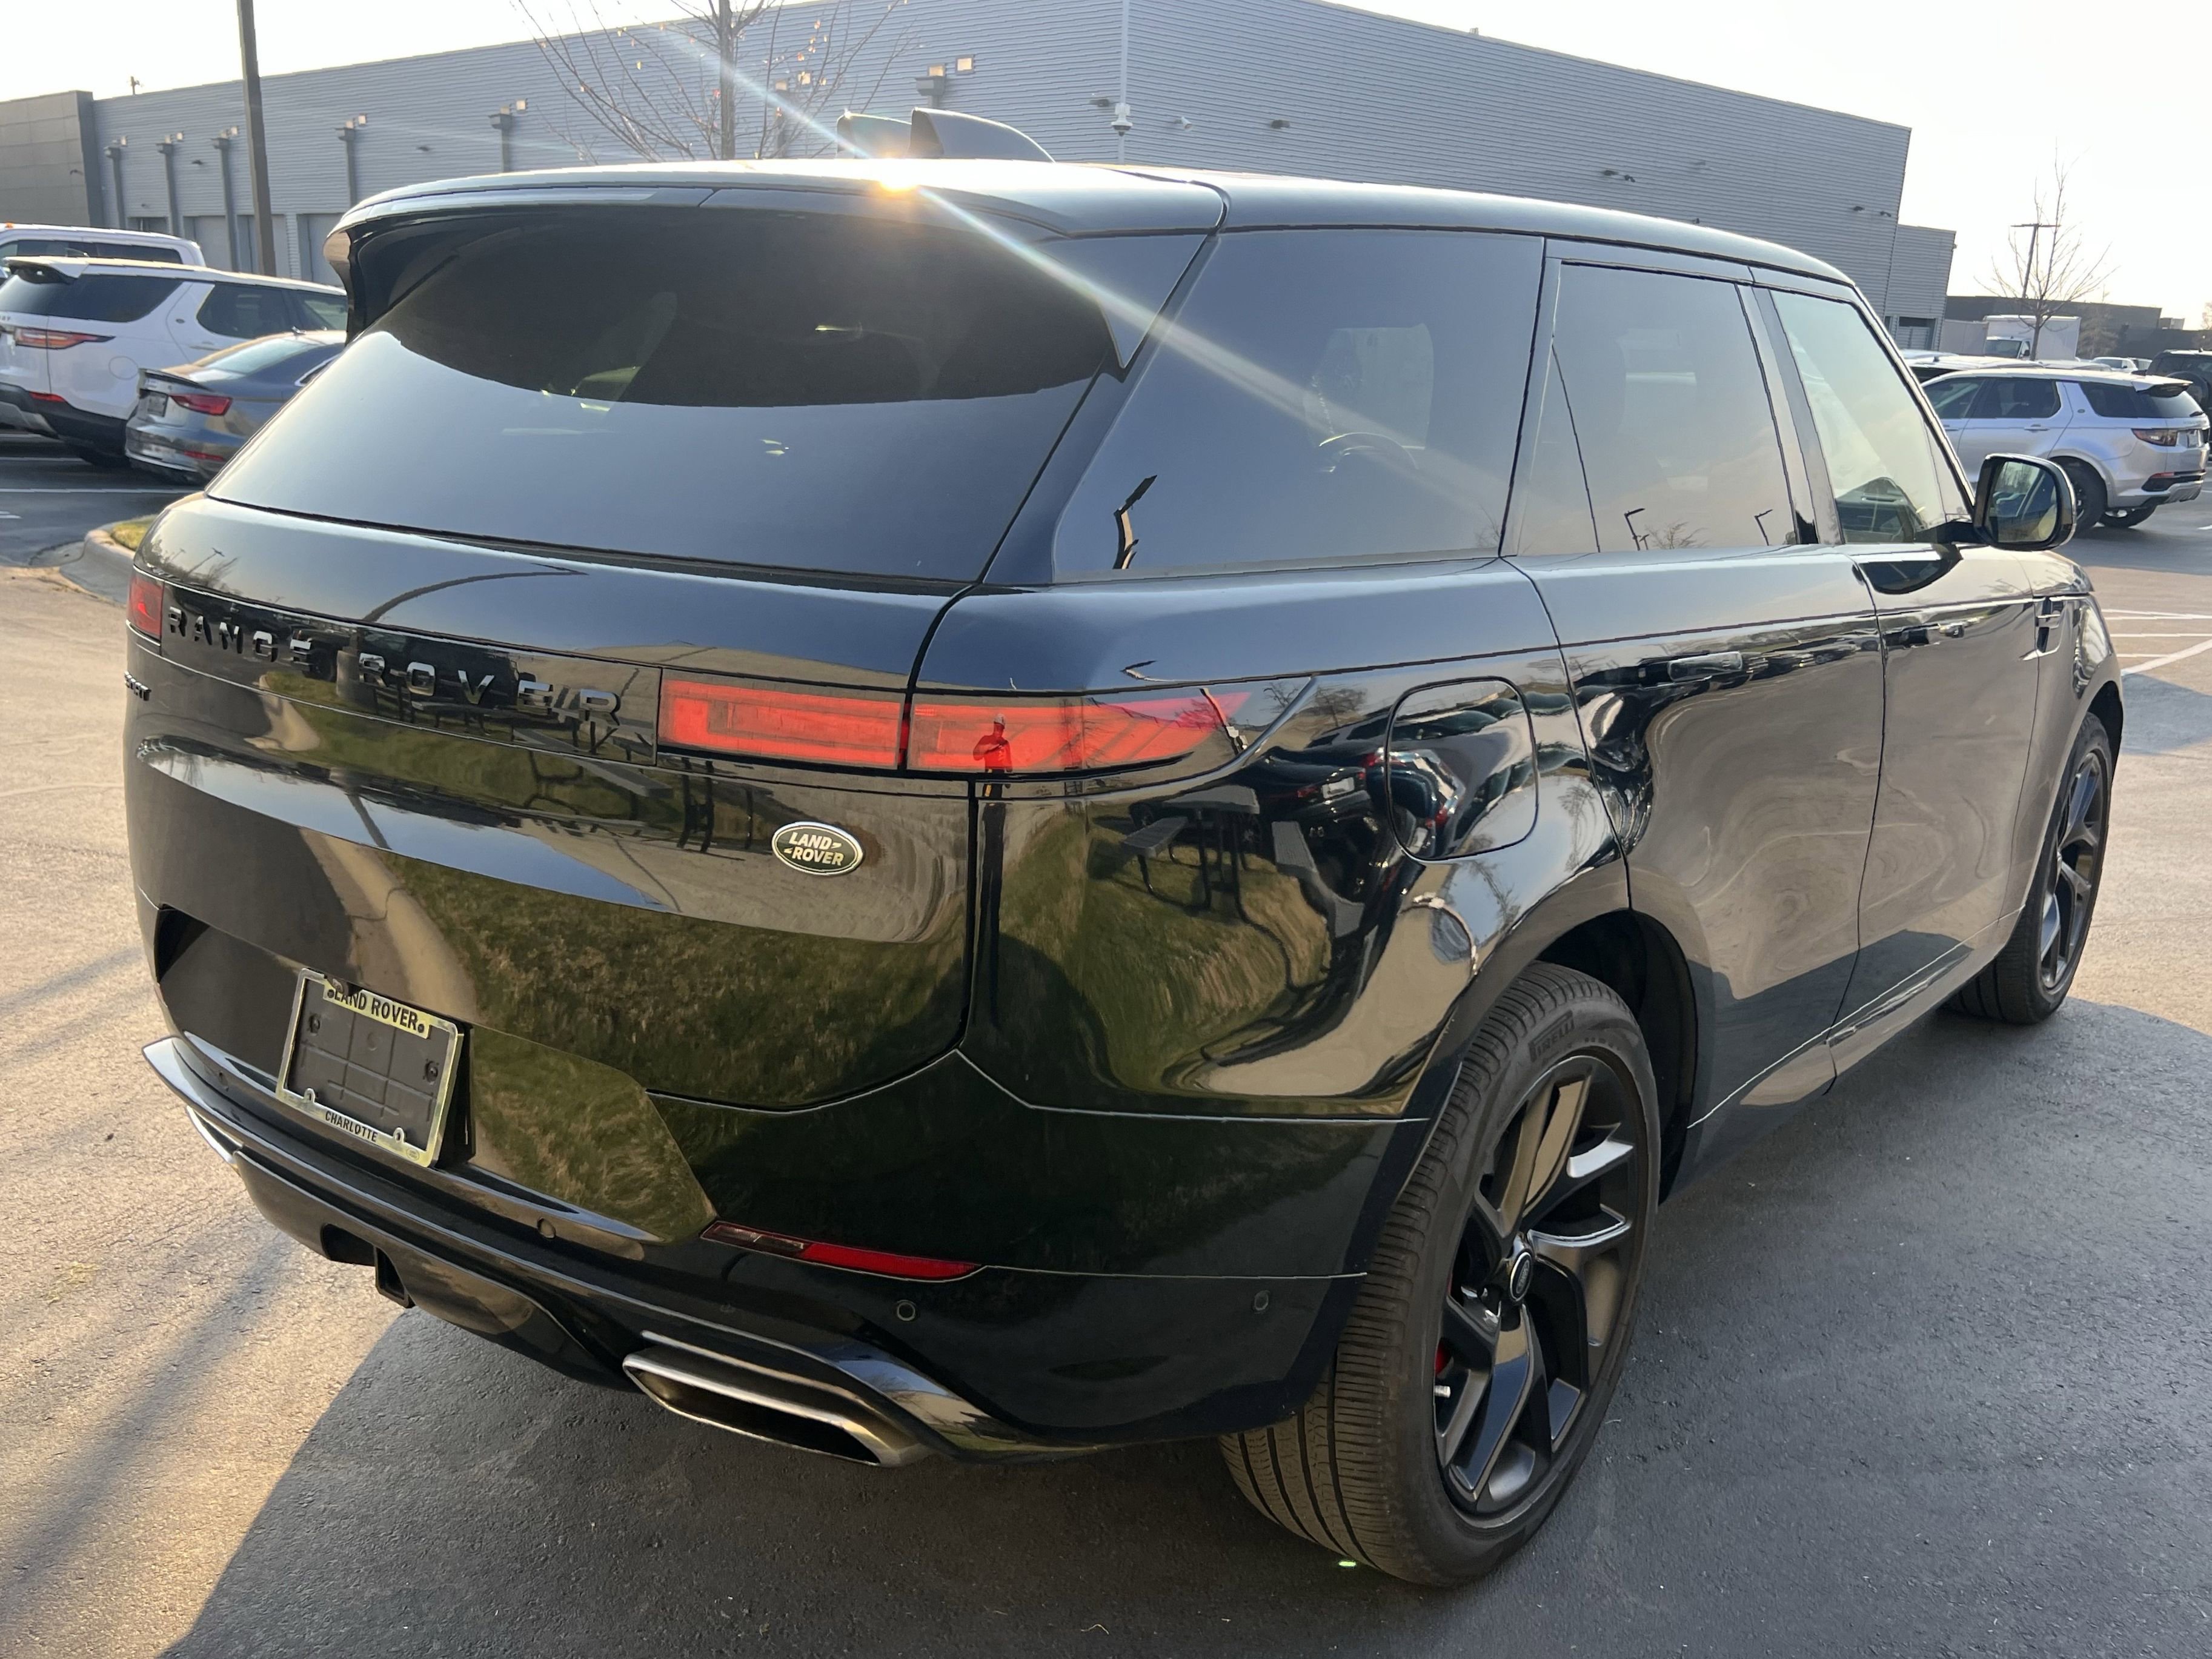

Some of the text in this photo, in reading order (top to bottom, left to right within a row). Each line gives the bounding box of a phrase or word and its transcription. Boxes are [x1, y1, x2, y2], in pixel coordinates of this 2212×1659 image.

[168, 605, 622, 729] RANGE ROVER
[788, 831, 833, 851] LAND
[791, 846, 845, 866] ROVER
[334, 989, 418, 1031] LAND ROVER
[325, 1109, 379, 1143] CHARLOTTE
